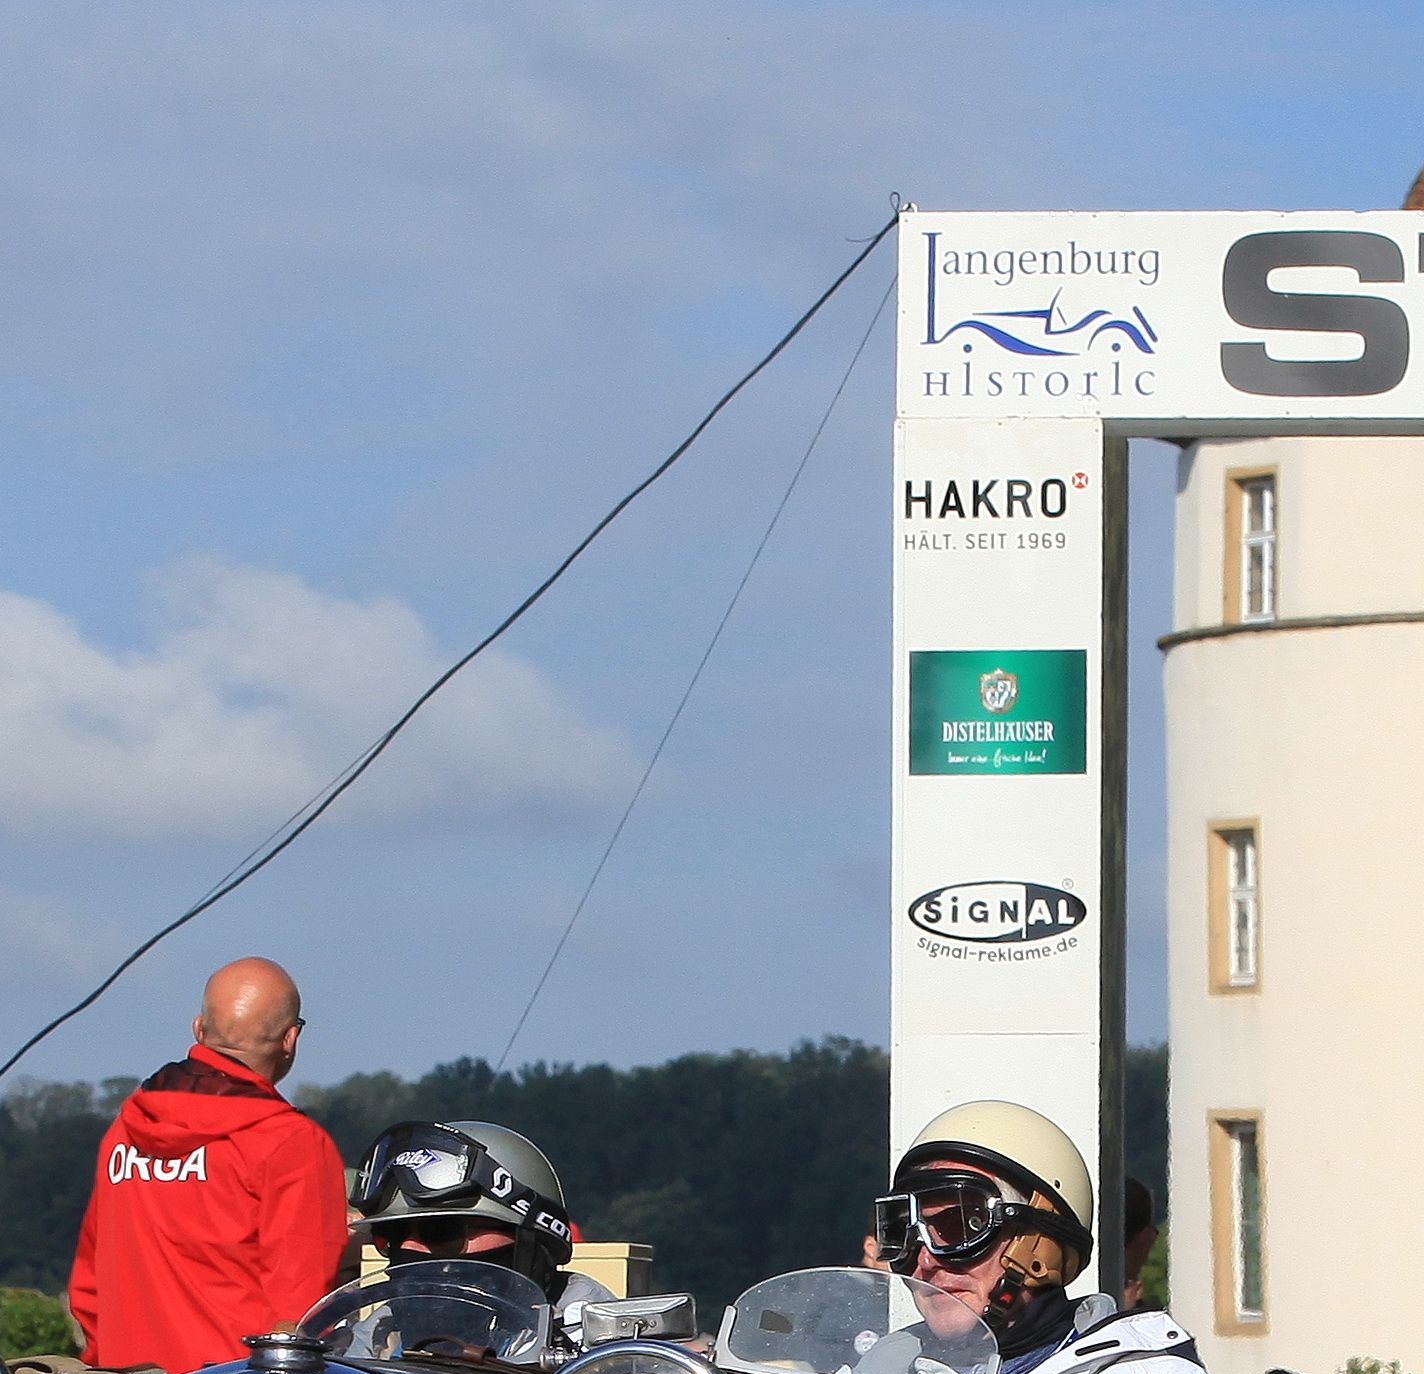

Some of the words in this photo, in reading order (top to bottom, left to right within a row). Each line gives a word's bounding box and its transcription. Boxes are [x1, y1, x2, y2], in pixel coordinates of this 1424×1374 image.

[920, 232, 1160, 341] Langenburg
[904, 478, 1067, 520] HAKRO
[904, 530, 957, 551] HÄLT.
[965, 533, 1007, 550] SEIT
[1017, 532, 1066, 549] 1969
[942, 720, 1055, 743] DISTELHÄUSER
[916, 937, 1078, 963] signal-reklame.de
[107, 1142, 208, 1185] ORGA
